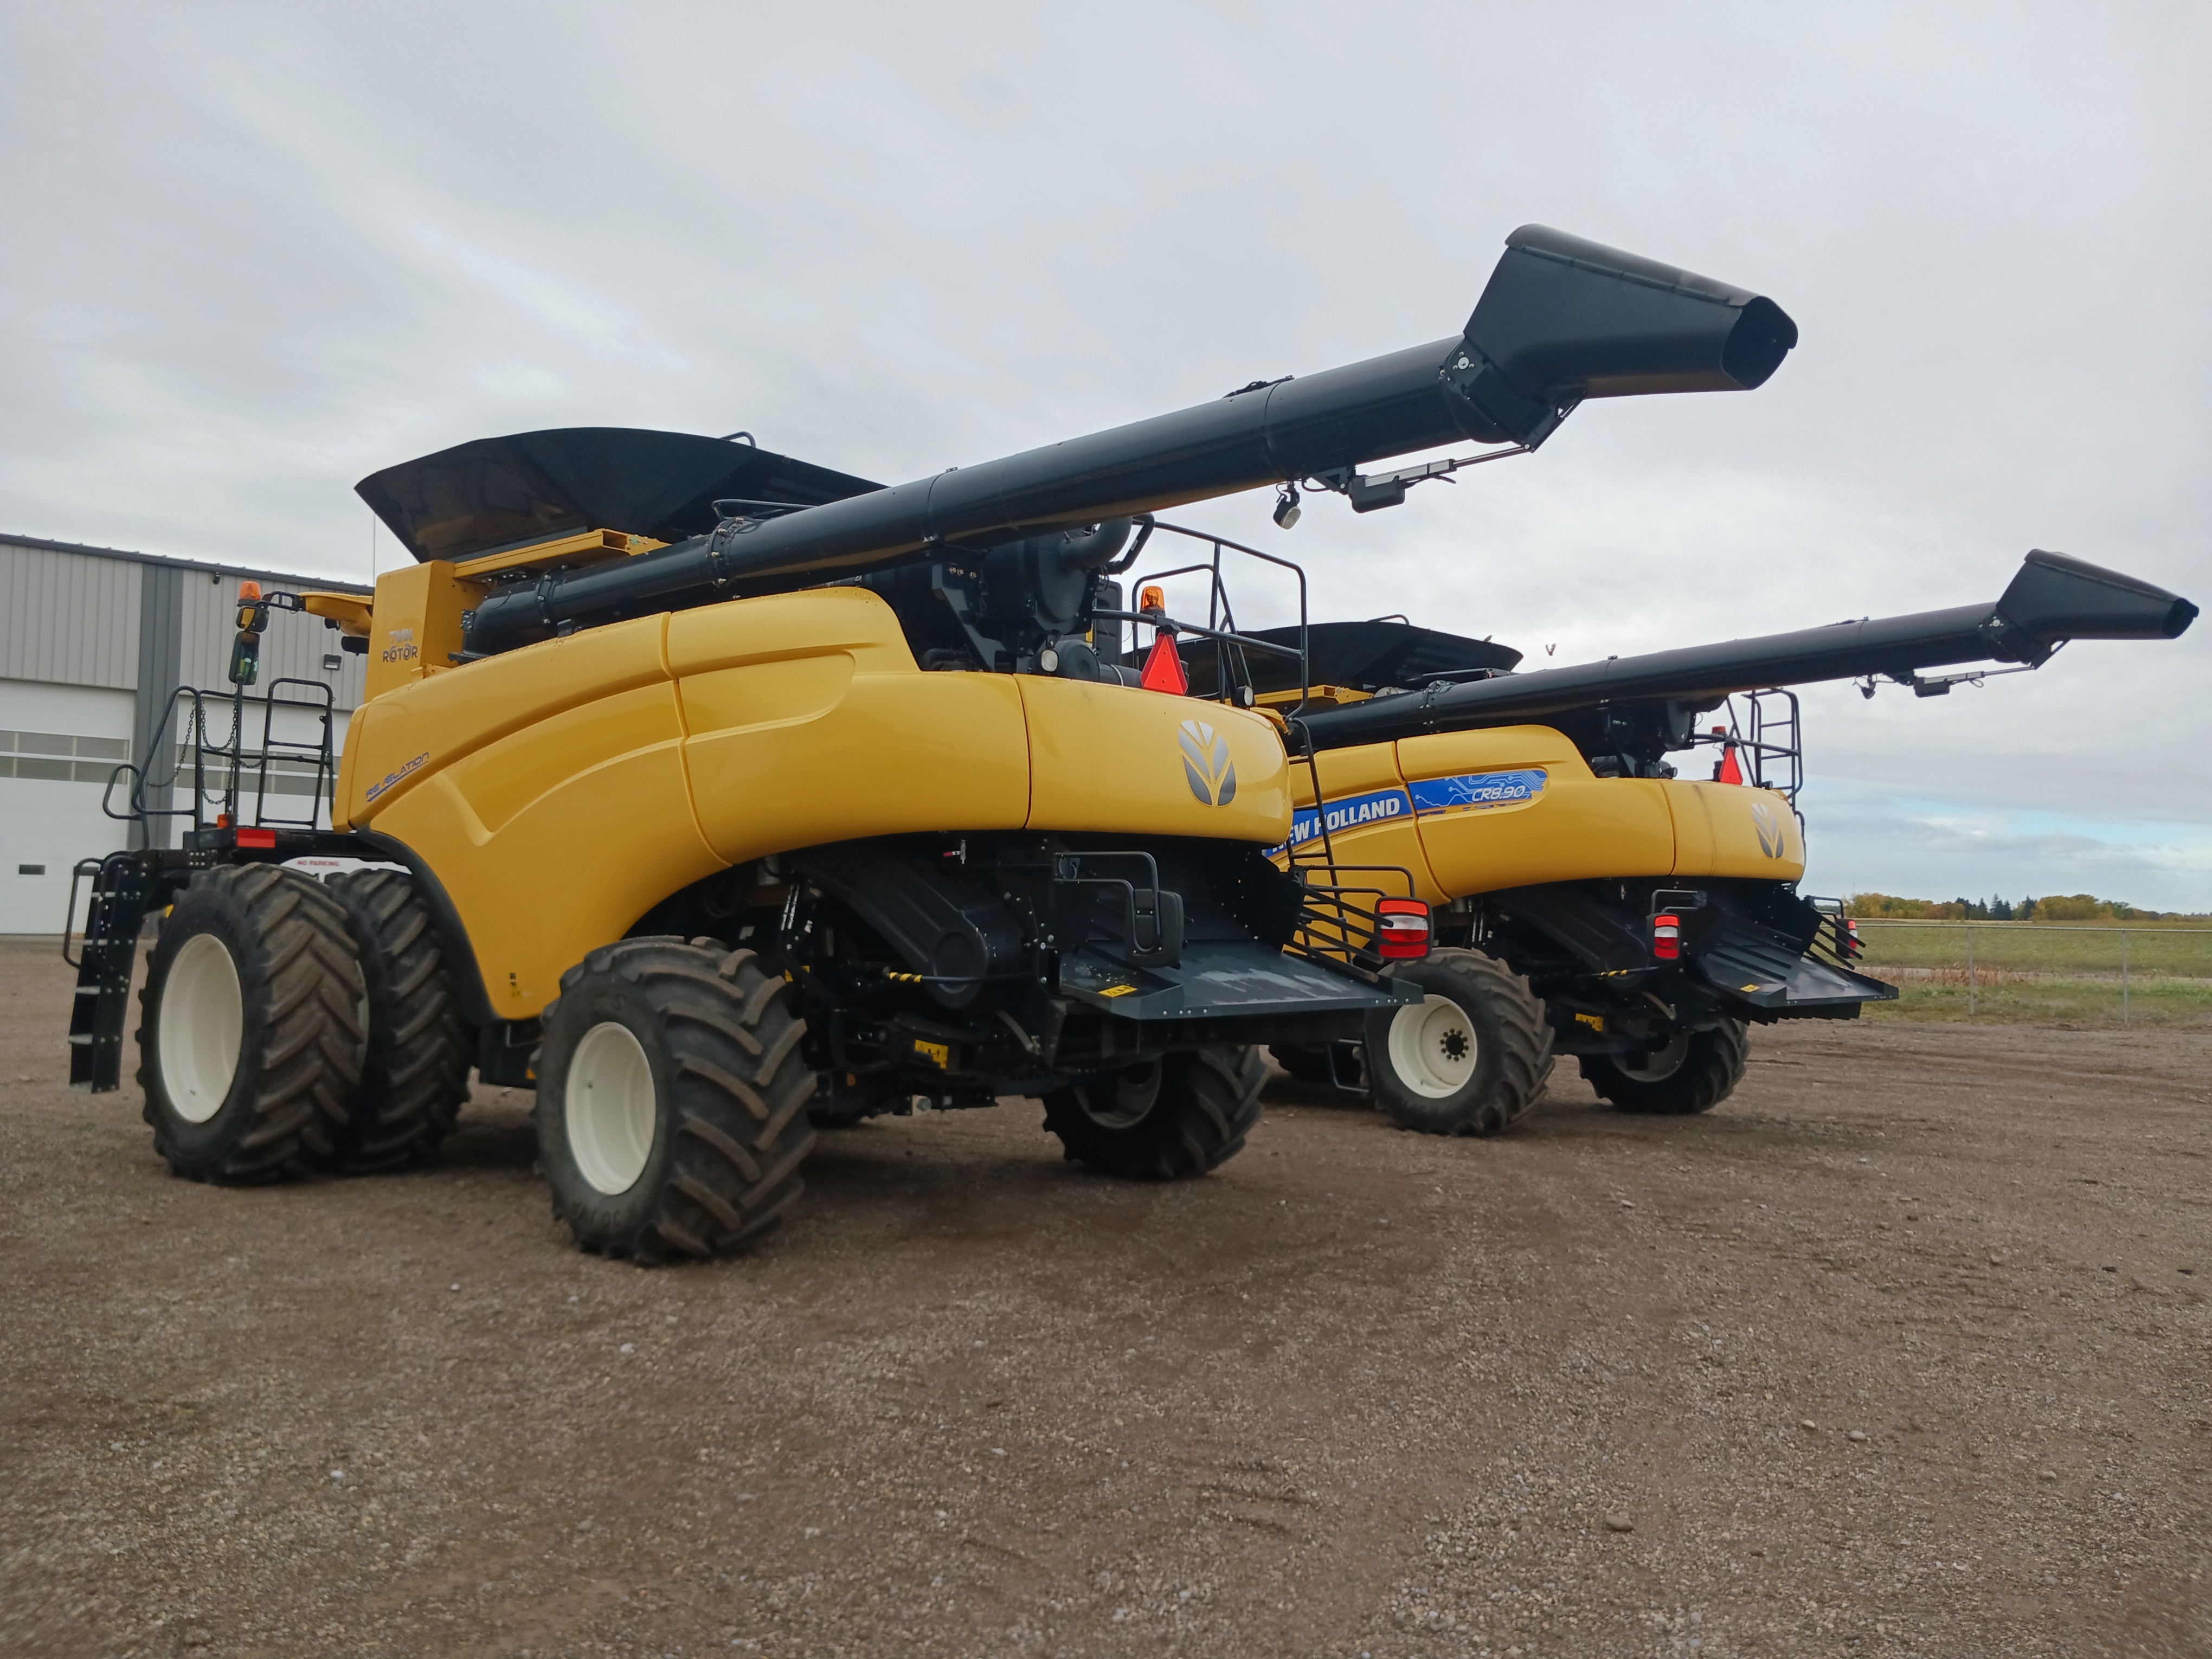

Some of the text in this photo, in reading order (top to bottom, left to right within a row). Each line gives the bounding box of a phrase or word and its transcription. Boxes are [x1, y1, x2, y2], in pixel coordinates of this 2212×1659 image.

[389, 628, 414, 644] TWIN
[382, 643, 419, 663] ROTOR
[1472, 785, 1526, 801] CR8.90
[1314, 797, 1400, 837] HOLLAND
